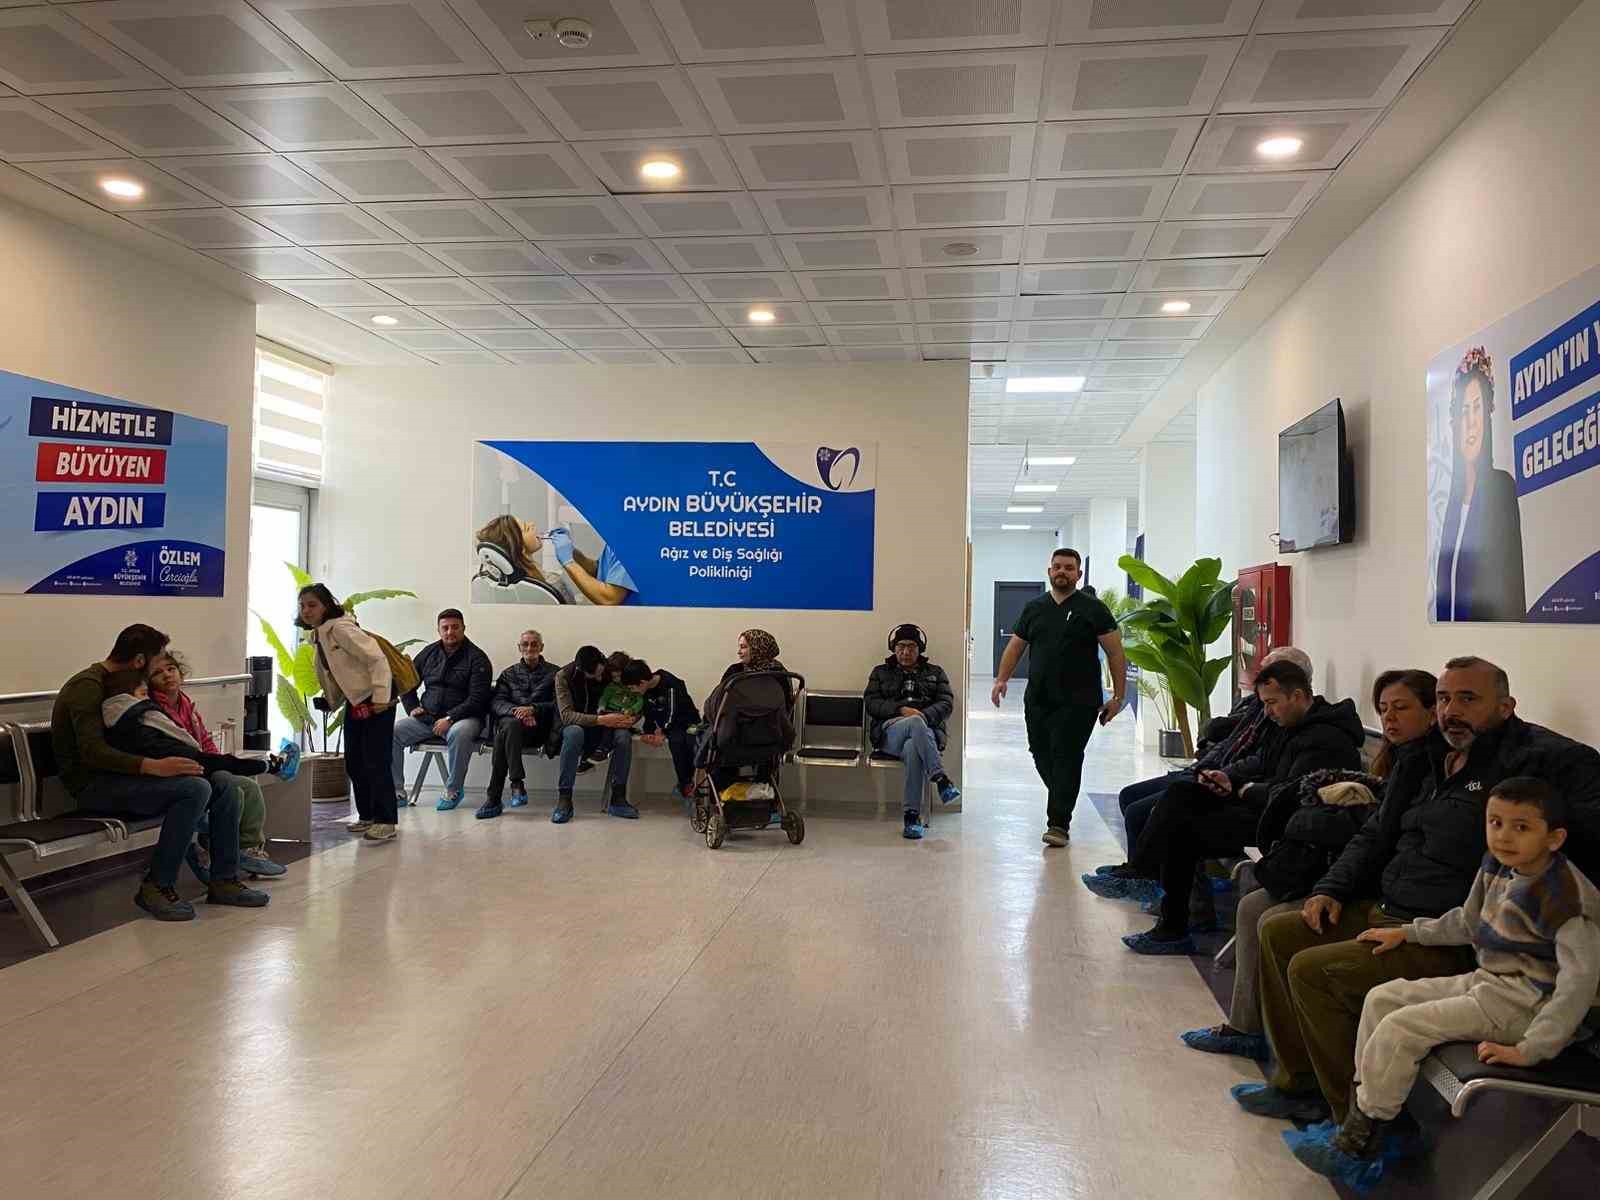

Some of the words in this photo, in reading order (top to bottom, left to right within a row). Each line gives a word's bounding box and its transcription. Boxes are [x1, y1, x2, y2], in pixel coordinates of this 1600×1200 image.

[1514, 327, 1590, 404] AYDIN'IN
[51, 401, 156, 438] HİZMETLE
[56, 446, 151, 478] BÜYÜYEN
[708, 470, 736, 487] T.C
[63, 496, 144, 526] AYDIN
[623, 496, 680, 512] AYDIN
[686, 491, 822, 518] BÜYÜKŞEHİR
[669, 518, 775, 538] BELEDİYESİ
[159, 545, 200, 566] ÖZLEM
[660, 547, 689, 561] Ağız
[693, 550, 708, 559] ve
[712, 547, 733, 562] Diş
[736, 547, 782, 562] Sağlığı
[689, 565, 752, 581] Polikliniği
